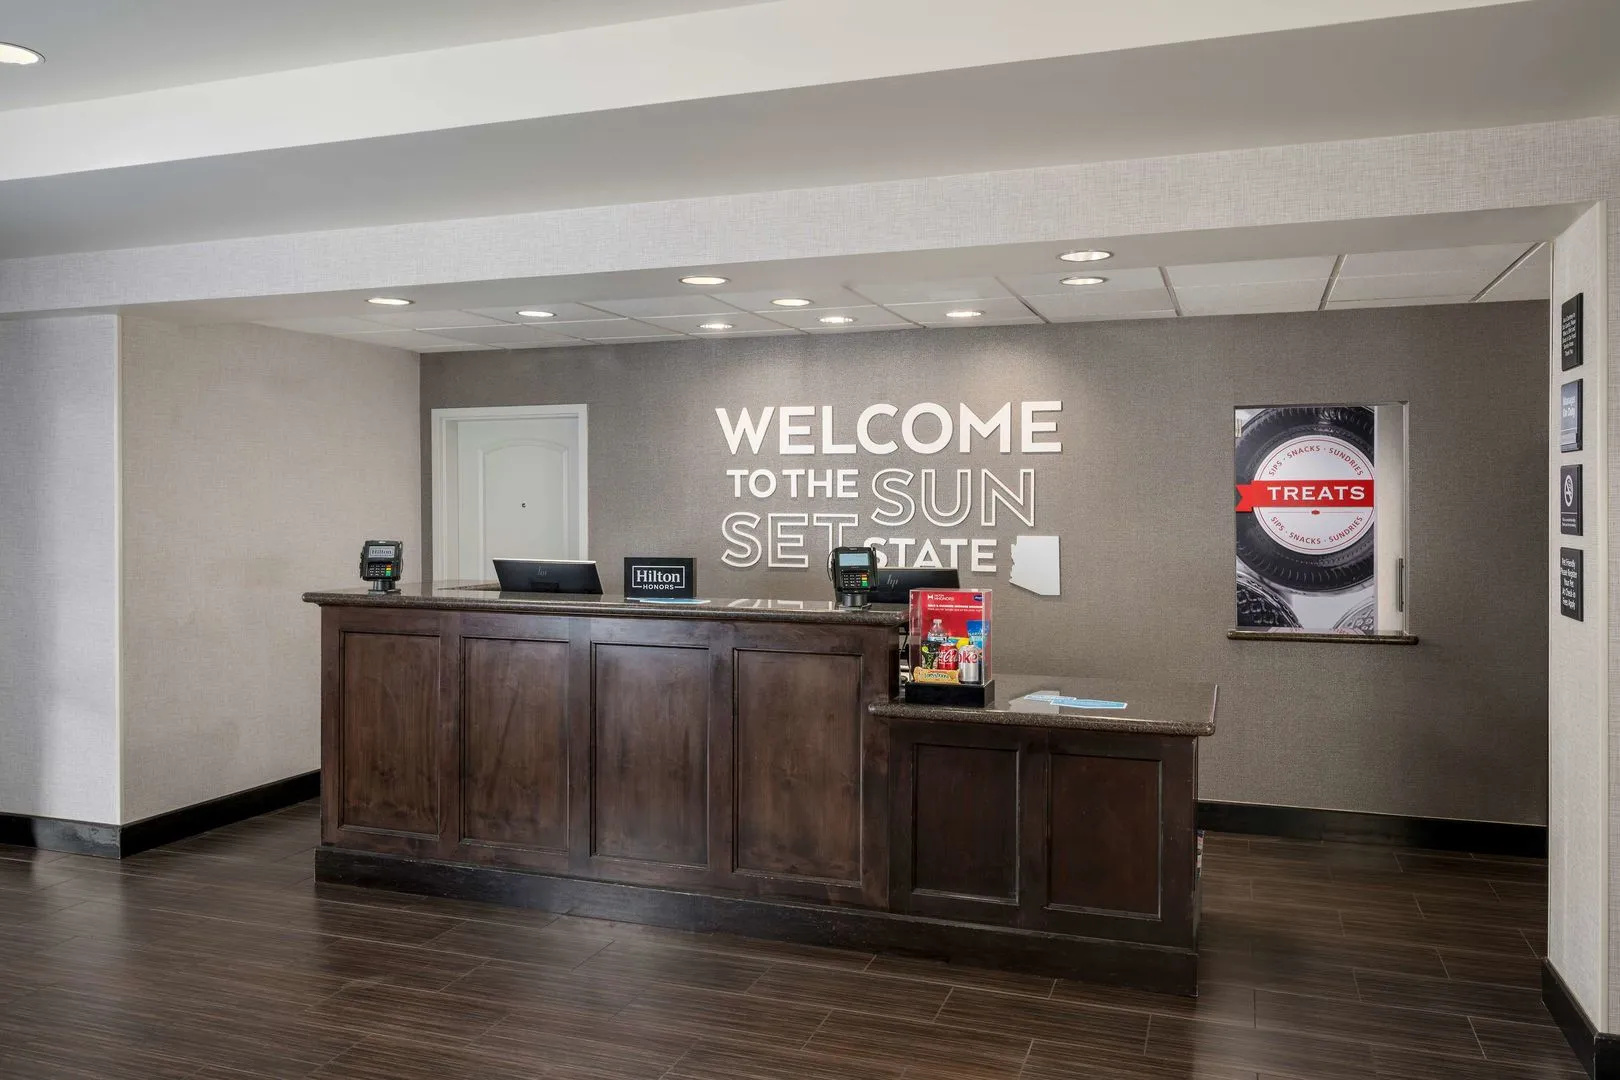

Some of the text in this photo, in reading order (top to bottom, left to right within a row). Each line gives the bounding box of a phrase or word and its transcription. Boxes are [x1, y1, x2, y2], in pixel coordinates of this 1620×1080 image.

[715, 400, 1062, 455] WELCOME
[1268, 445, 1364, 476] SIPS SNACKS SUNDRIES
[726, 468, 1035, 527] TO THE SUN
[1267, 485, 1365, 501] TREATS
[721, 511, 997, 572] SET STATE
[1270, 515, 1363, 545] SIPS SNACKS SUNDRIES
[636, 569, 680, 583] Hilton
